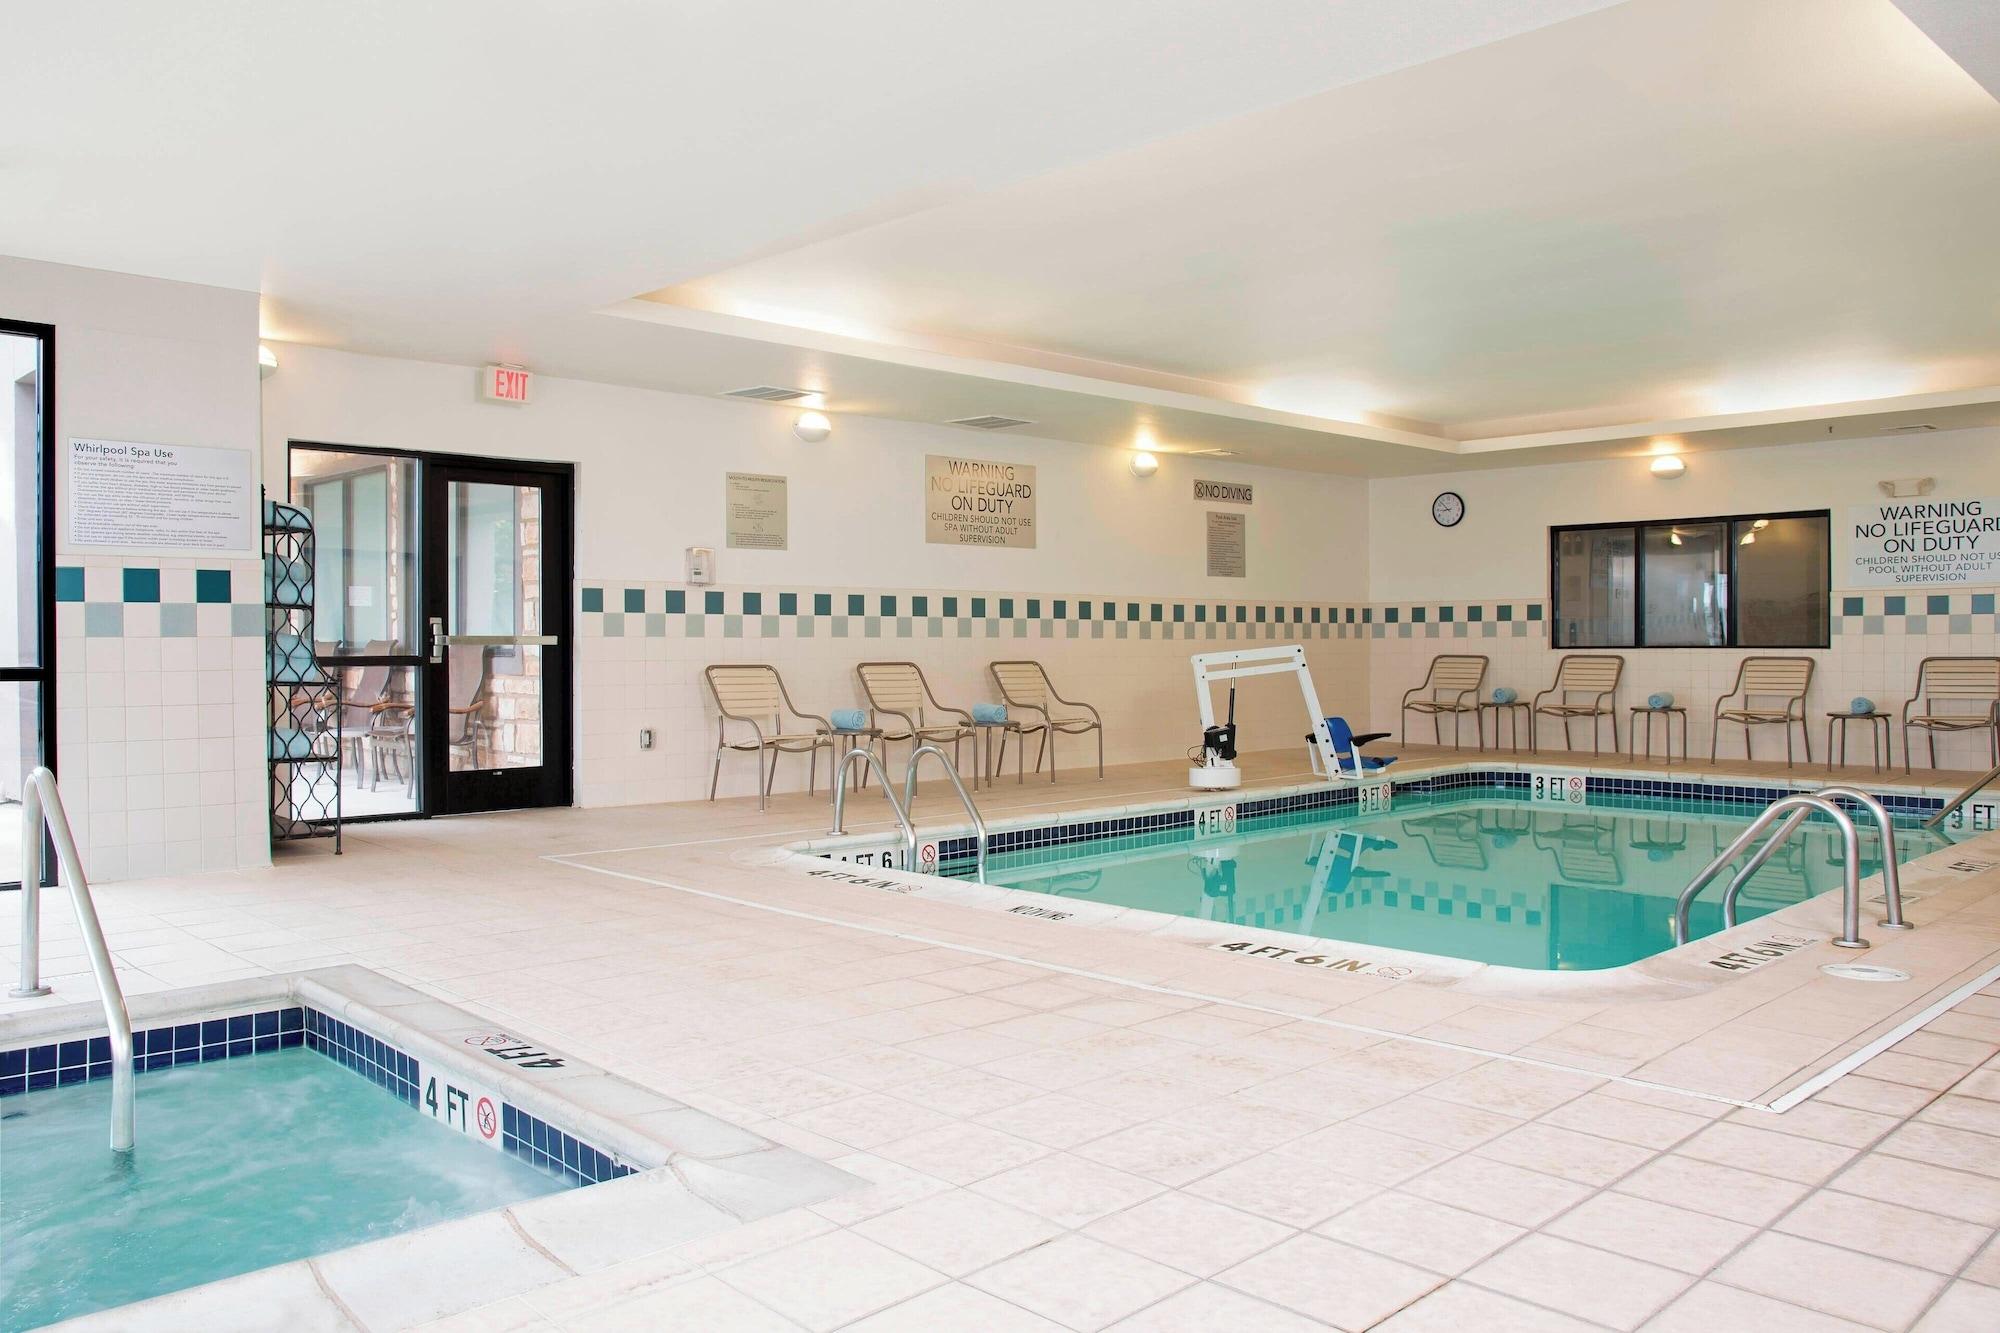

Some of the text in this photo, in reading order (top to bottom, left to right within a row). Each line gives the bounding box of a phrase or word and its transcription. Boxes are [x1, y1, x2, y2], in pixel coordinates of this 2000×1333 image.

[496, 370, 528, 400] EXIT
[74, 442, 173, 458] Whirlpool Spa Use
[948, 460, 1015, 481] WARNING
[931, 476, 1032, 499] NO LIFEGUARD
[1205, 484, 1252, 501] NO DIVING
[951, 496, 1014, 514] ON DUTY
[1880, 501, 1982, 521] WARNING
[931, 512, 1032, 527] CHILDREN SHOULD NOT USE
[1856, 517, 2000, 539] NO LIFEGUAR
[944, 523, 1018, 535] SPA WITHOUT ADULT
[959, 533, 1006, 544] SUPERVISION
[1884, 535, 1980, 553] ON DUTY
[1855, 555, 1908, 566] CHILDREN
[1911, 553, 1957, 564] SHOULD
[1960, 552, 1985, 561] NOT
[1868, 562, 1992, 574] POOL WITHOUT ADULT
[1895, 573, 1967, 583] SUPERVISION
[1536, 776, 1566, 789] 3 FT
[1198, 811, 1206, 824] 4
[882, 851, 892, 868] 6
[1221, 942, 1254, 952] 4
[1294, 955, 1329, 965] 6
[1708, 960, 1751, 970] 4
[1743, 946, 1784, 957] 6
[518, 1058, 567, 1068] 4
[426, 1076, 469, 1133] 4 FT
